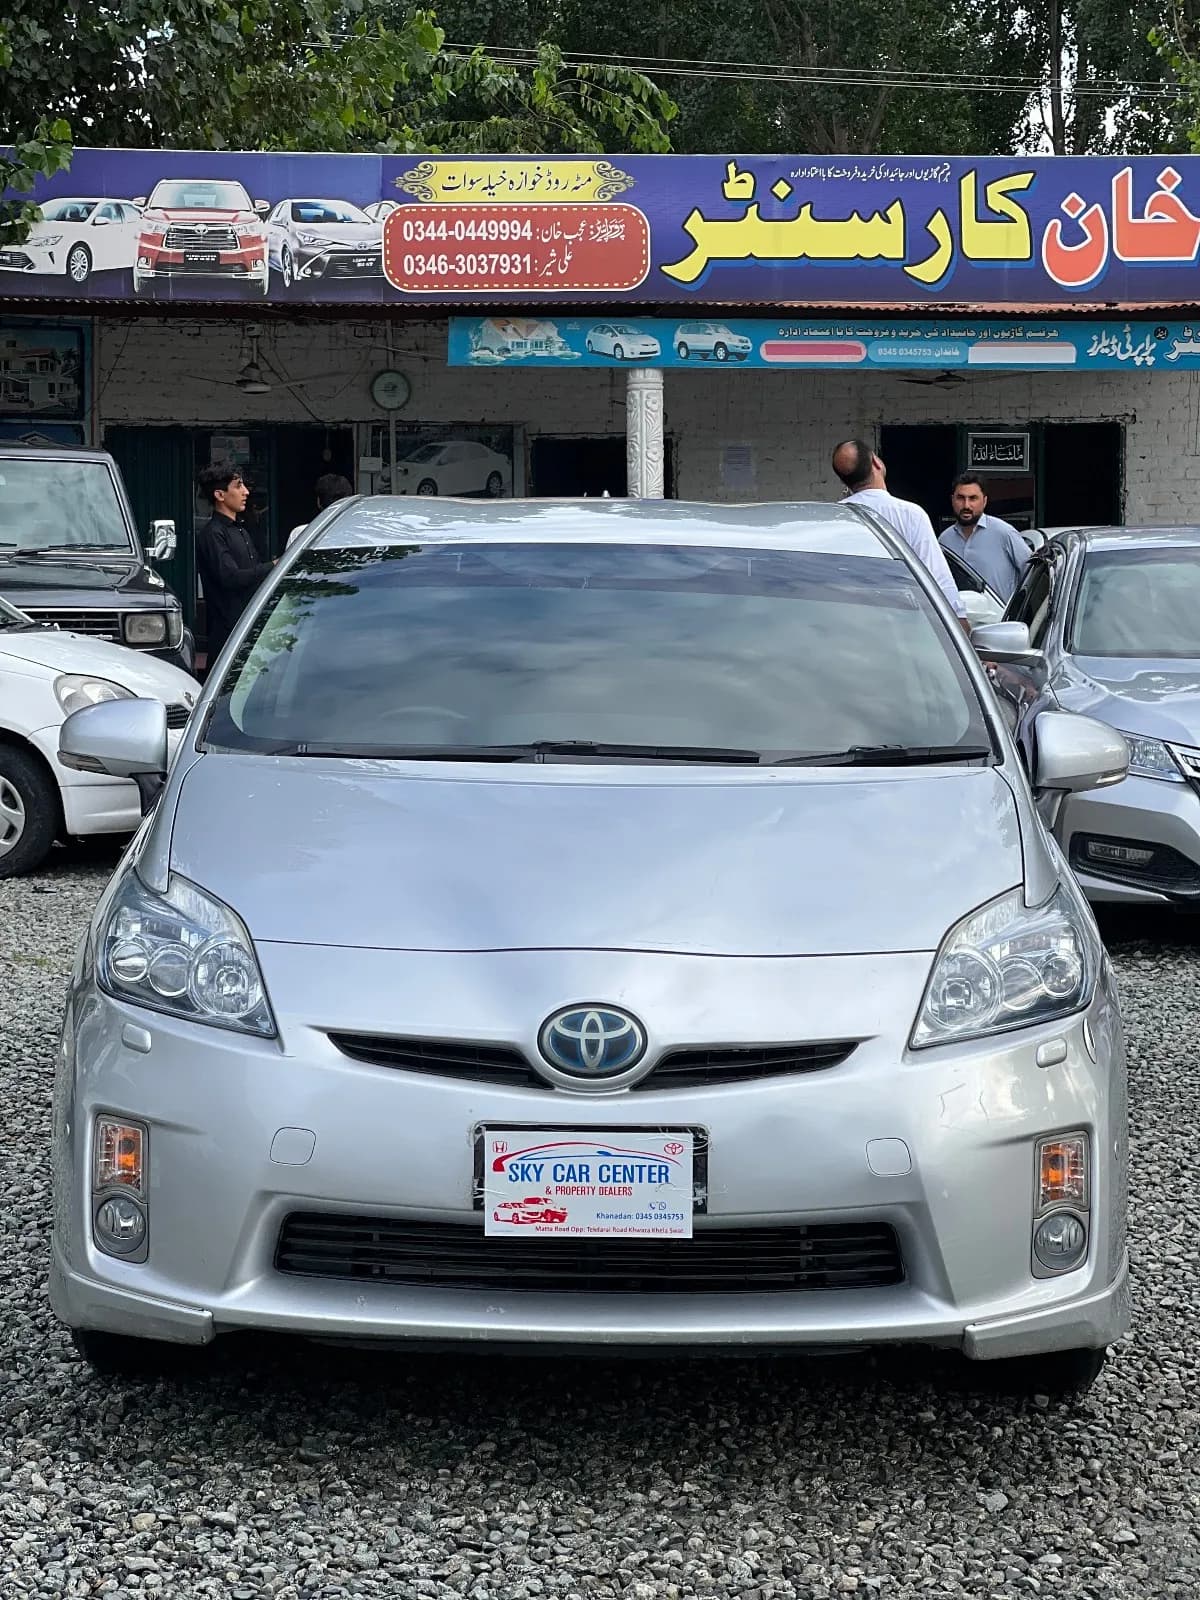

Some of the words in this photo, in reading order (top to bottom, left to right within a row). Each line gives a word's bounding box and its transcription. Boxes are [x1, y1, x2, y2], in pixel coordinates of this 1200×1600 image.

[441, 171, 482, 191] سوات
[481, 170, 507, 197] خیلہ
[508, 166, 543, 191] خوازہ
[545, 168, 569, 191] روڈ
[571, 173, 592, 192] مٹہ
[403, 220, 533, 241] 0344-0449994
[563, 219, 587, 245] عجب
[660, 160, 905, 284] سنٹر
[903, 171, 1036, 284] کار
[1041, 166, 1200, 288] خان
[403, 254, 532, 275] 0346-3037931
[558, 245, 573, 274] علی
[1086, 330, 1120, 357] ڈیلرز
[1117, 323, 1157, 366] پراپرٹی
[508, 1163, 544, 1183] SKY
[552, 1163, 590, 1183] CAR
[598, 1164, 670, 1184] CENTER
[545, 1186, 552, 1195] &
[555, 1186, 596, 1196] PROPERTY
[599, 1187, 633, 1196] DEALERS
[596, 1212, 634, 1220] Khanadan:
[653, 1213, 684, 1221] 0345753
